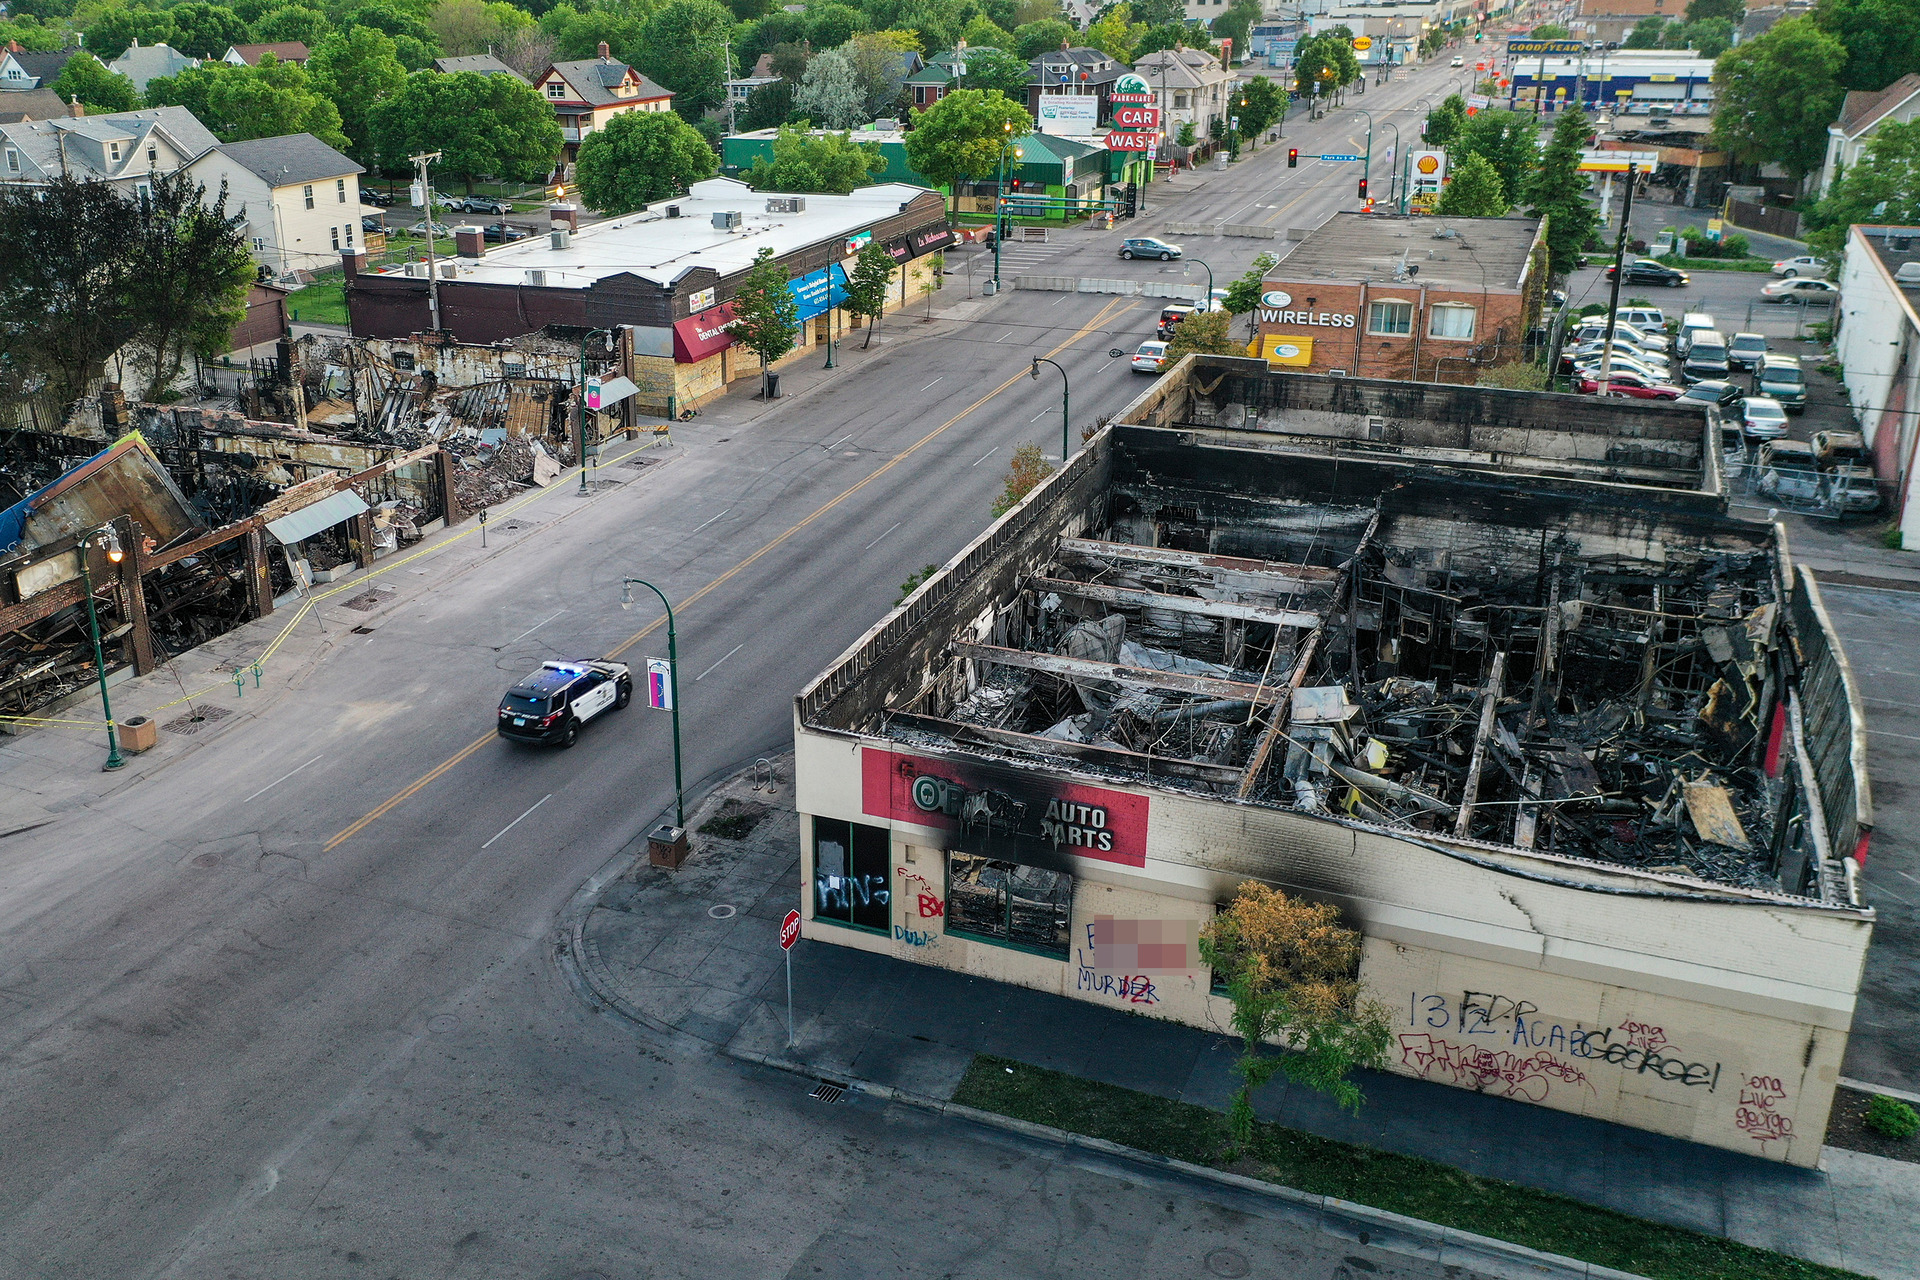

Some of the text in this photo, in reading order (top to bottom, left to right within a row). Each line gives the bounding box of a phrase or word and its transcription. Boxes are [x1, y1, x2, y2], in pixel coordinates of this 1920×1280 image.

[1122, 111, 1152, 124] CAR
[1110, 135, 1155, 148] WASH
[1261, 310, 1355, 327] WIRELESS
[698, 328, 719, 341] DENTAL
[596, 694, 613, 707] POLICE
[1045, 798, 1106, 828] AUTO
[781, 917, 799, 944] STOP
[1078, 968, 1160, 1001] MURDER
[1513, 1016, 1593, 1058] ACAB
